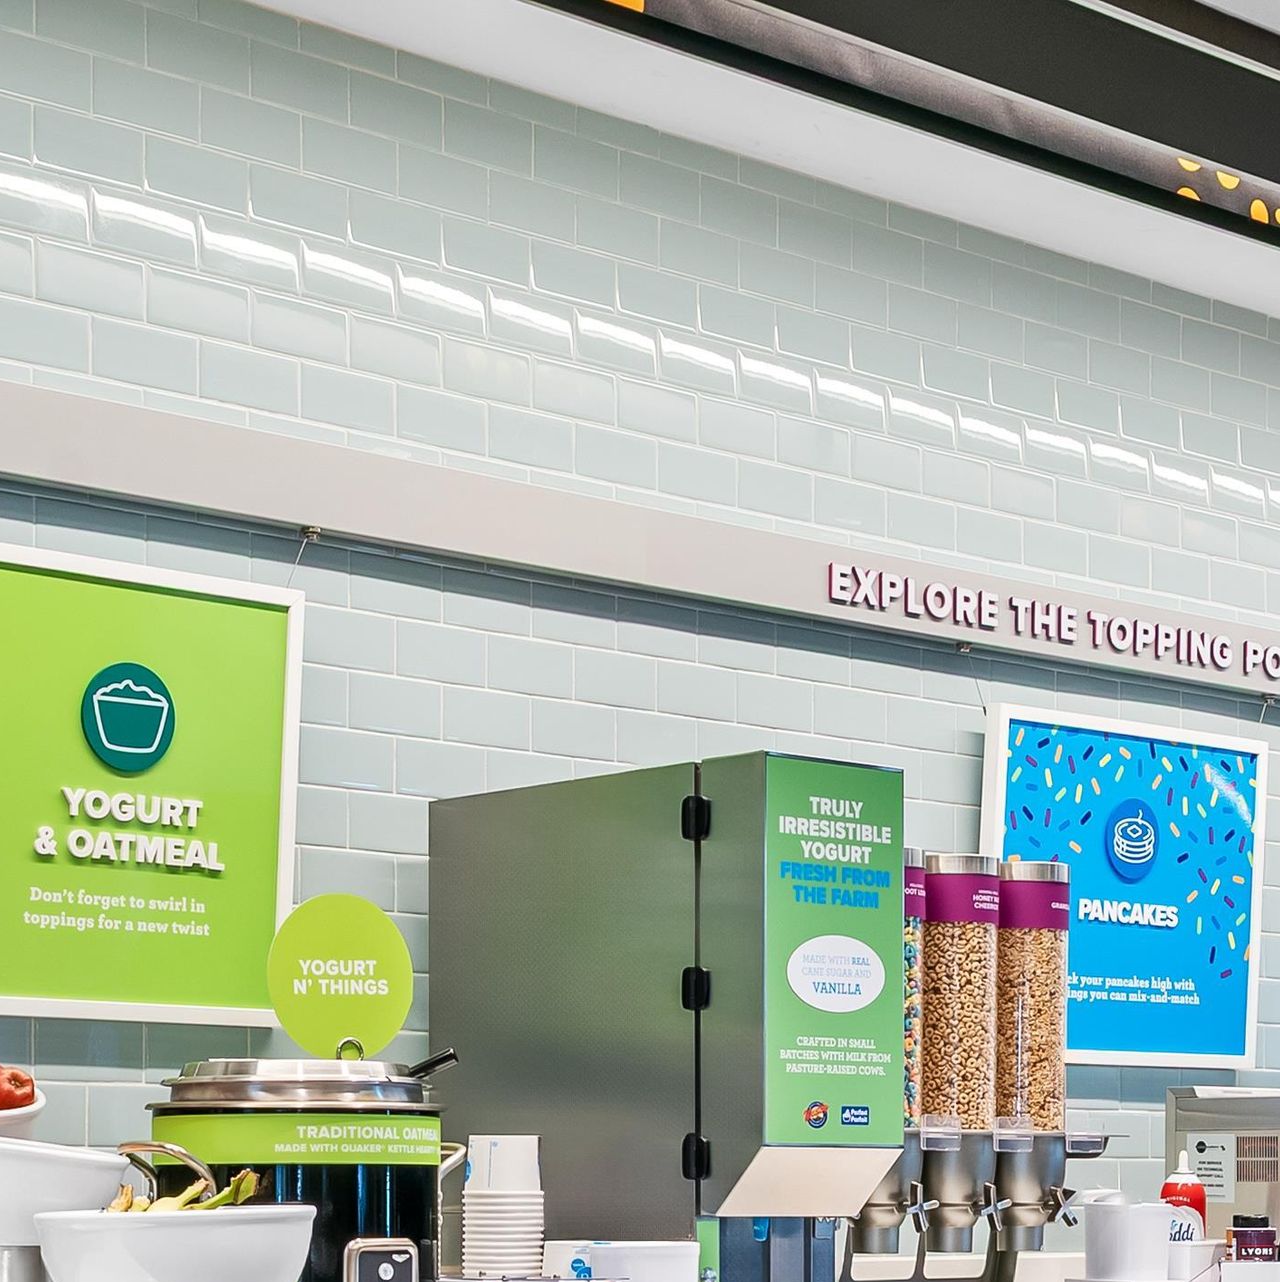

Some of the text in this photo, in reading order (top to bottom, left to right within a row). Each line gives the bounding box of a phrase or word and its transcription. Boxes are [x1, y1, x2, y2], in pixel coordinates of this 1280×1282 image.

[828, 562, 1000, 631] EXPLORE
[1009, 596, 1078, 645] THE
[1087, 610, 1234, 669] TOPPING
[61, 787, 204, 828] YOGURT
[809, 796, 863, 819] TRULY
[779, 815, 892, 844] IRRESISTIBLE
[34, 826, 225, 872] & OATMEAL
[800, 840, 873, 864] YOGURT
[780, 861, 890, 888] FRESH FROM
[77, 889, 126, 910] forget
[129, 895, 146, 909] to
[149, 896, 188, 912] swirl
[190, 898, 206, 913] in
[792, 885, 880, 909] THE FARM
[972, 894, 994, 902] HONEY
[1078, 898, 1179, 928] PANCAKES
[24, 911, 210, 936] toppings for a new twist
[298, 959, 377, 976] YOGURT
[802, 954, 871, 966] MADE WITH REAL
[801, 967, 872, 979] CANE SUGAR AND
[318, 979, 389, 995] THINGS
[812, 981, 862, 995] VANILLA
[1080, 976, 1104, 988] your
[1105, 974, 1150, 989] pancakes
[1150, 976, 1173, 993] high
[1173, 978, 1196, 991] with
[1067, 987, 1200, 1005] ings you can mix-and-match
[797, 1036, 876, 1049] CRAFTED IN SMALL
[780, 1049, 891, 1063] BATCHES WITH MILK FROM
[786, 1063, 886, 1076] PASTURE-RAISED COWS.
[297, 1126, 400, 1140] TRADITIONAL
[274, 1143, 308, 1153] MADE
[310, 1144, 338, 1153] WITH
[387, 1145, 418, 1153] KETTLE
[1169, 1223, 1195, 1241] ddi
[1241, 1247, 1274, 1256] LYONS
